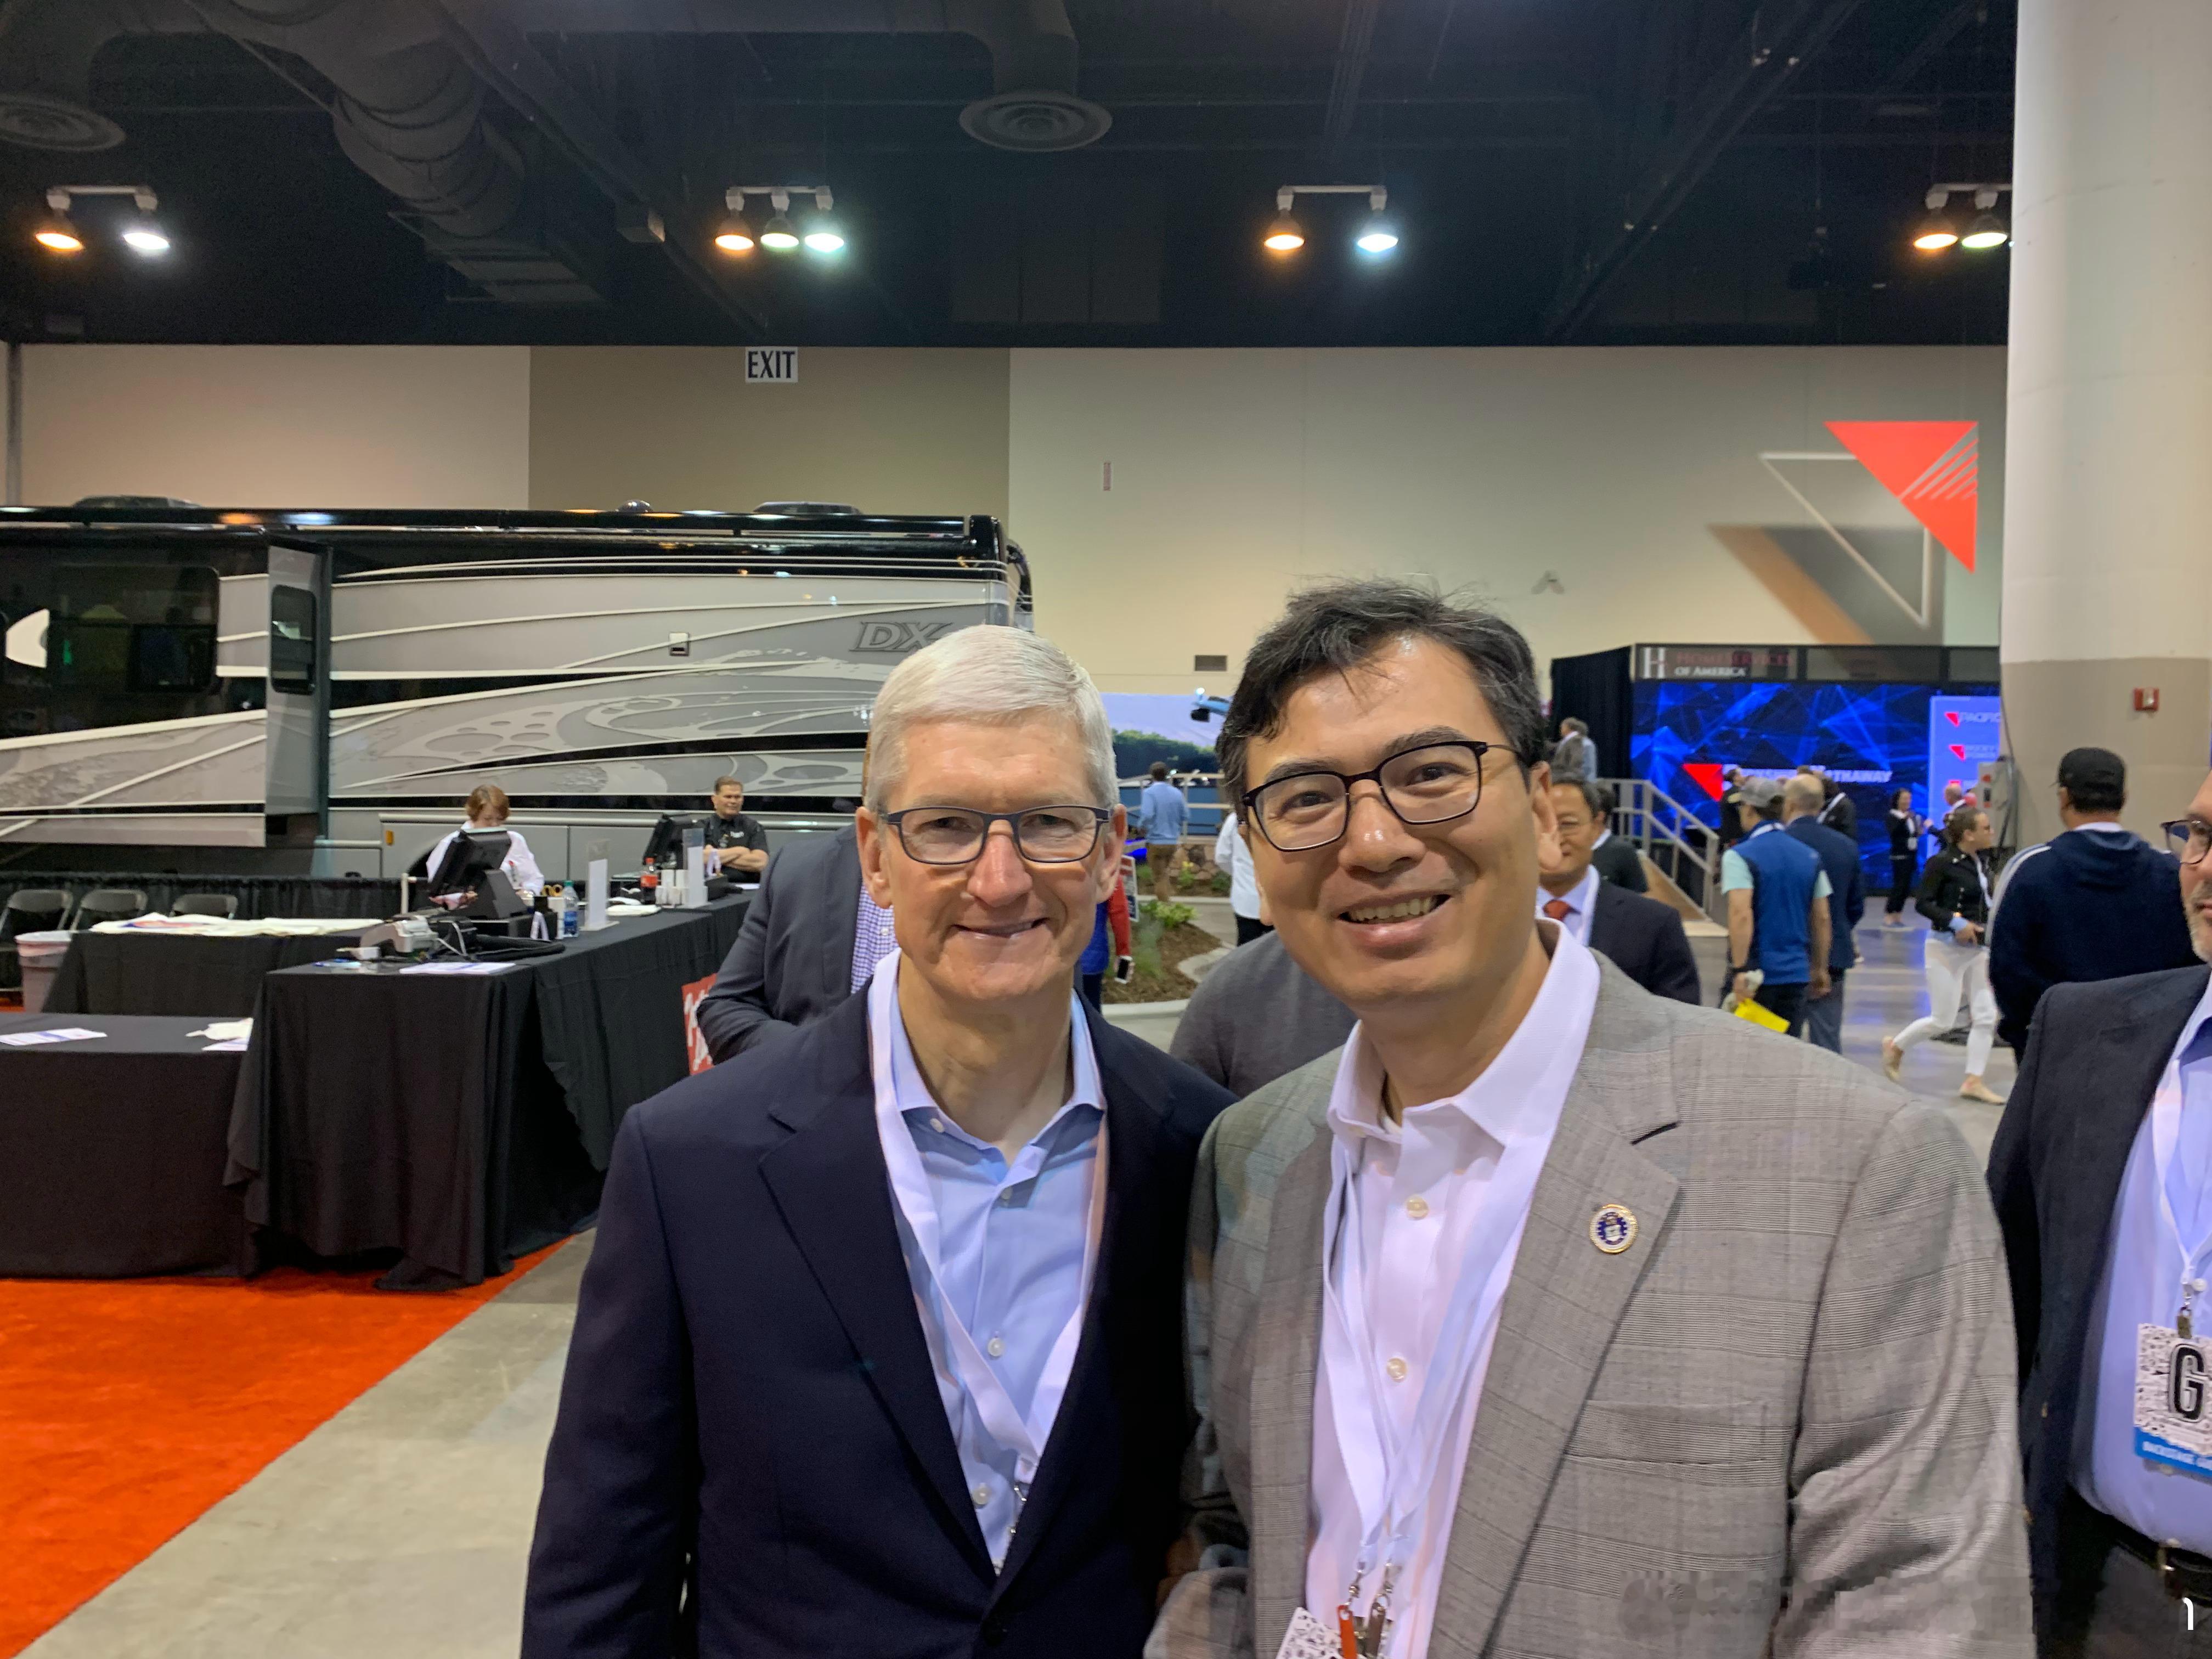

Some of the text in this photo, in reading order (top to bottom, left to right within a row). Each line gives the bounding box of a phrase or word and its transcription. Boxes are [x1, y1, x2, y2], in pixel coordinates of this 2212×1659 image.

[748, 351, 795, 378] EXIT
[849, 622, 953, 652] DX
[2172, 1345, 2204, 1422] G
